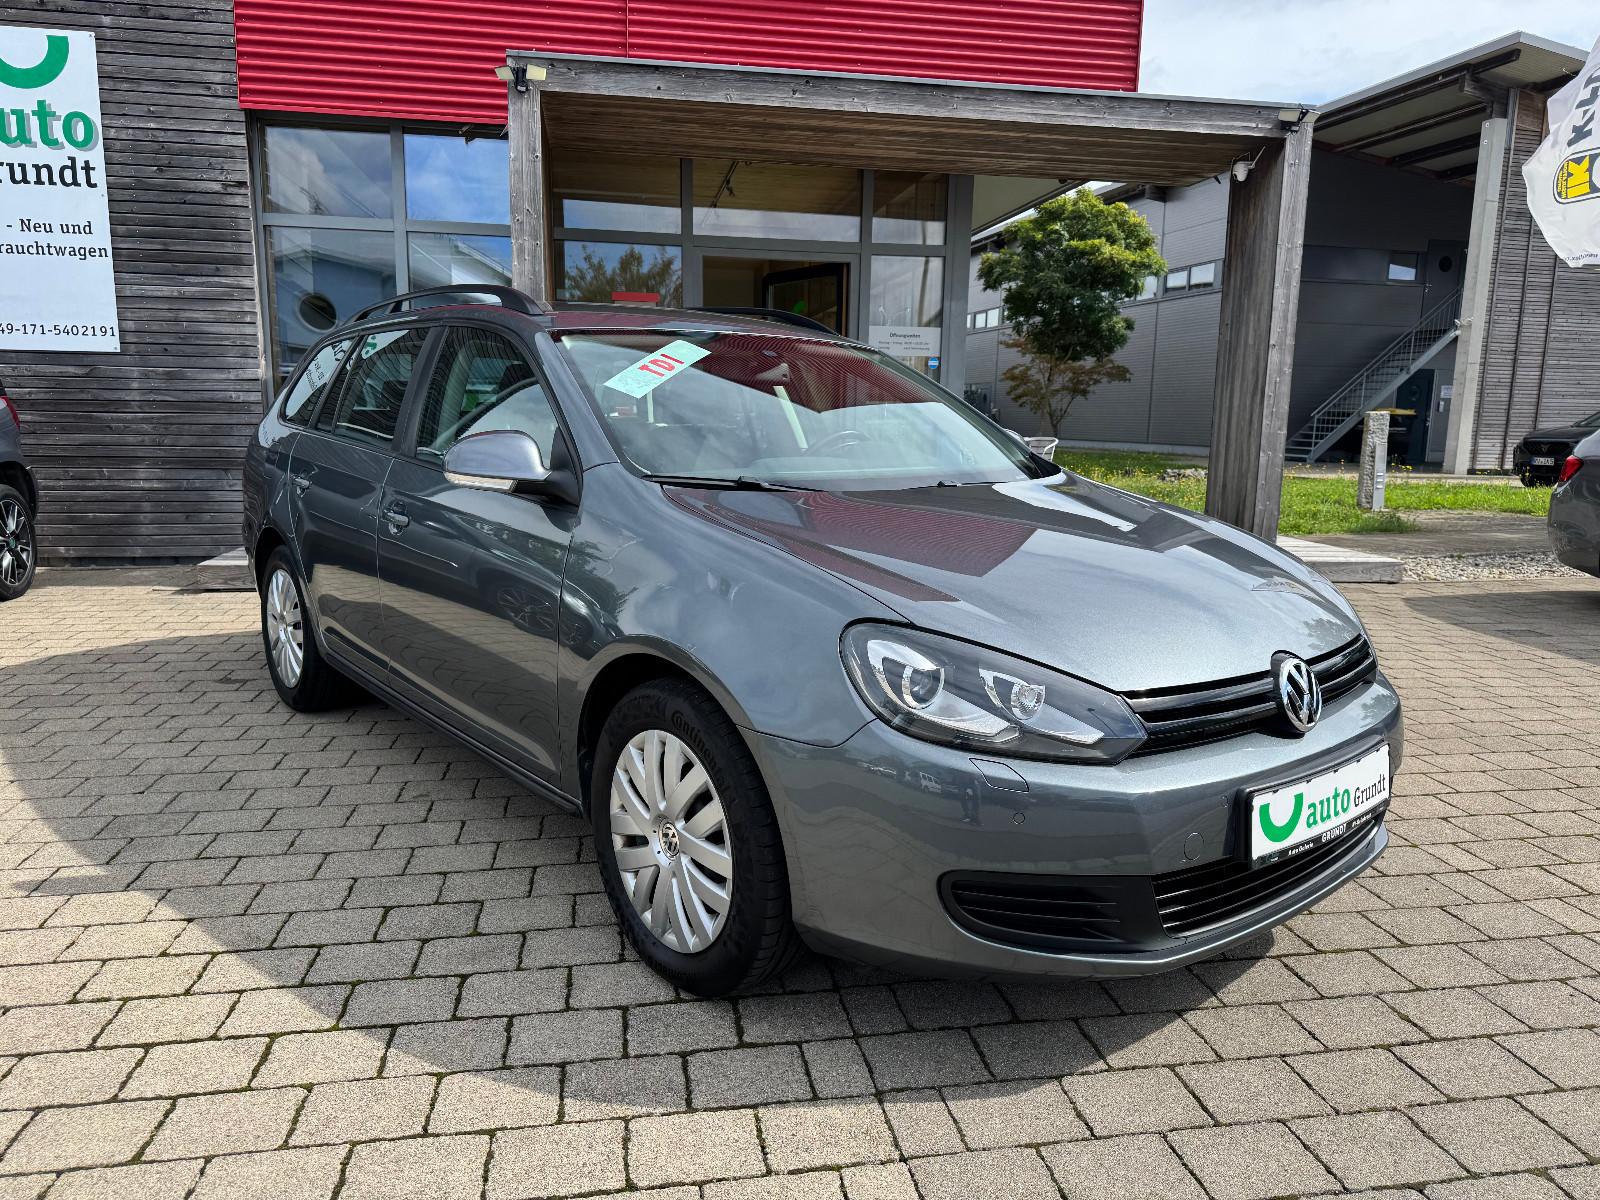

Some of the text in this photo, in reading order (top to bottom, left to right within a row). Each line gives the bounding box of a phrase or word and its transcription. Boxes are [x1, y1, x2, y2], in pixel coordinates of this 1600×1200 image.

[19, 218, 53, 233] Neu
[60, 220, 93, 235] und
[637, 353, 685, 377] TDI
[1305, 786, 1351, 829] auto
[1353, 773, 1386, 808] Grundt
[1321, 823, 1347, 843] GRUNDT
